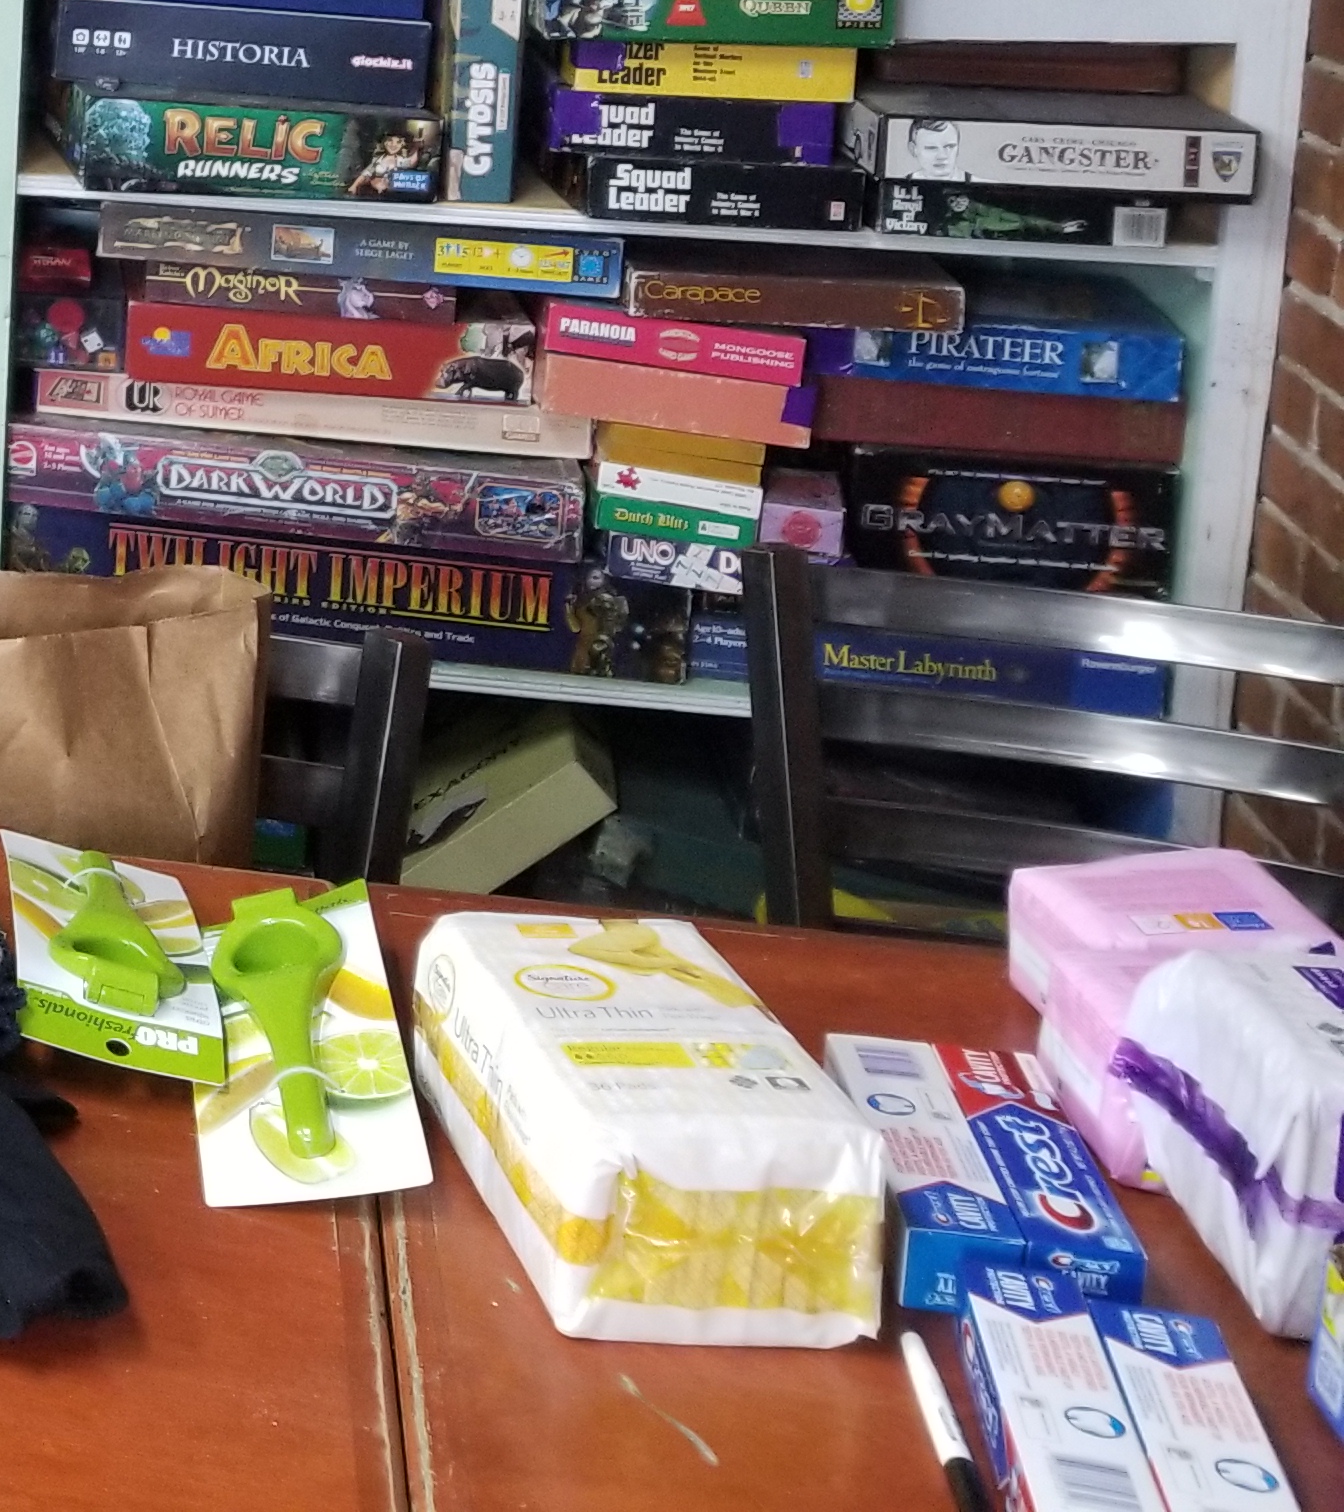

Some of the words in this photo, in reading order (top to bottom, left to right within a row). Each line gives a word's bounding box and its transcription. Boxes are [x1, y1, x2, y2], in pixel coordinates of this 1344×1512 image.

[171, 37, 311, 69] HISTORIA
[463, 61, 499, 176] CYTOSIS
[163, 107, 327, 164] RELIC
[176, 158, 301, 185] RUNNERS
[998, 143, 1153, 171] GANGSTER
[608, 163, 692, 193] Squad
[607, 186, 692, 214] Leader
[368, 240, 395, 249] GAME
[397, 241, 409, 250] BY
[645, 280, 762, 305] Carapace
[560, 317, 636, 342] PARANOIA
[205, 323, 393, 380] AFRICA
[710, 351, 795, 370] PUBLISHING
[714, 342, 795, 360] MONGOOSE
[908, 330, 1066, 367] PIRATEER
[908, 357, 923, 368] the
[925, 361, 953, 373] game
[132, 378, 165, 411] UR
[175, 388, 217, 407] ROYAL
[220, 391, 265, 407] GAME
[175, 402, 197, 416] OF
[199, 403, 245, 422] SUMER
[614, 507, 654, 525] Dutch
[656, 512, 690, 531] Blitz
[862, 503, 1168, 552] GRAYMATTER
[620, 536, 676, 566] UNO
[108, 528, 318, 599] TWILIGHT
[327, 551, 552, 626] IMPERIUM
[320, 601, 389, 616] EDITION
[278, 613, 290, 624] of
[291, 614, 332, 629] Galactic
[424, 629, 444, 641] and
[445, 631, 476, 645] Trade
[822, 642, 896, 673] Master
[896, 650, 997, 686] Labyrinth
[535, 1006, 598, 1020] Ultra
[598, 1006, 655, 1019] Thin
[134, 1025, 200, 1056] PRO
[453, 1007, 480, 1064] Ultra
[480, 1044, 504, 1130] Thin
[963, 1048, 1002, 1083] CAVITY
[994, 1113, 1099, 1235] Crest
[949, 1191, 990, 1231] CAVITY
[995, 1270, 1037, 1312] CAVITY
[1131, 1312, 1178, 1357] CAVITY
